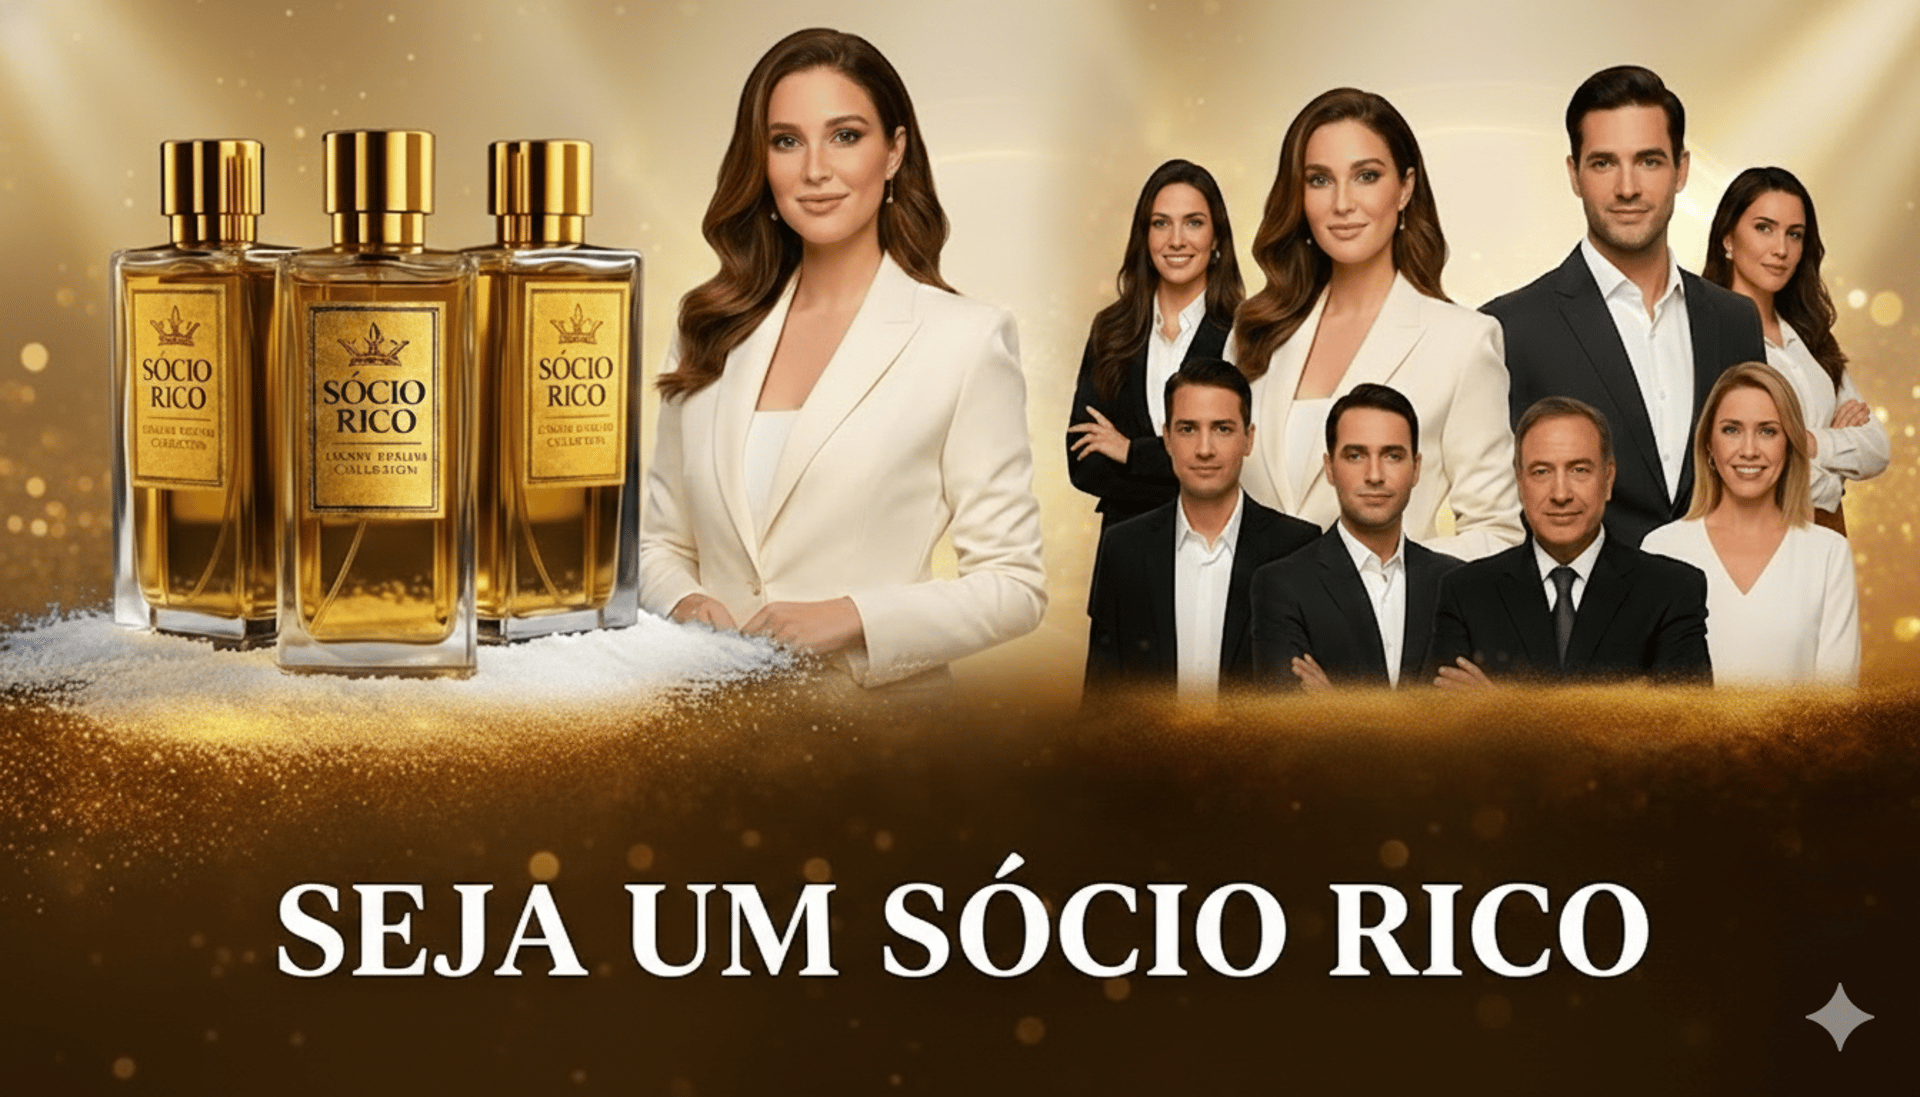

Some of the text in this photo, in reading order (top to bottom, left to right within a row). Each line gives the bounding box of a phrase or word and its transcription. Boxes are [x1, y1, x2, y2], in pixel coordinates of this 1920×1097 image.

[143, 351, 212, 382] SÓCIO
[539, 350, 613, 380] SÓCIO
[151, 386, 207, 410] RICO
[323, 371, 426, 404] SÓCIO
[547, 384, 606, 407] RICO
[336, 409, 417, 434] RICO
